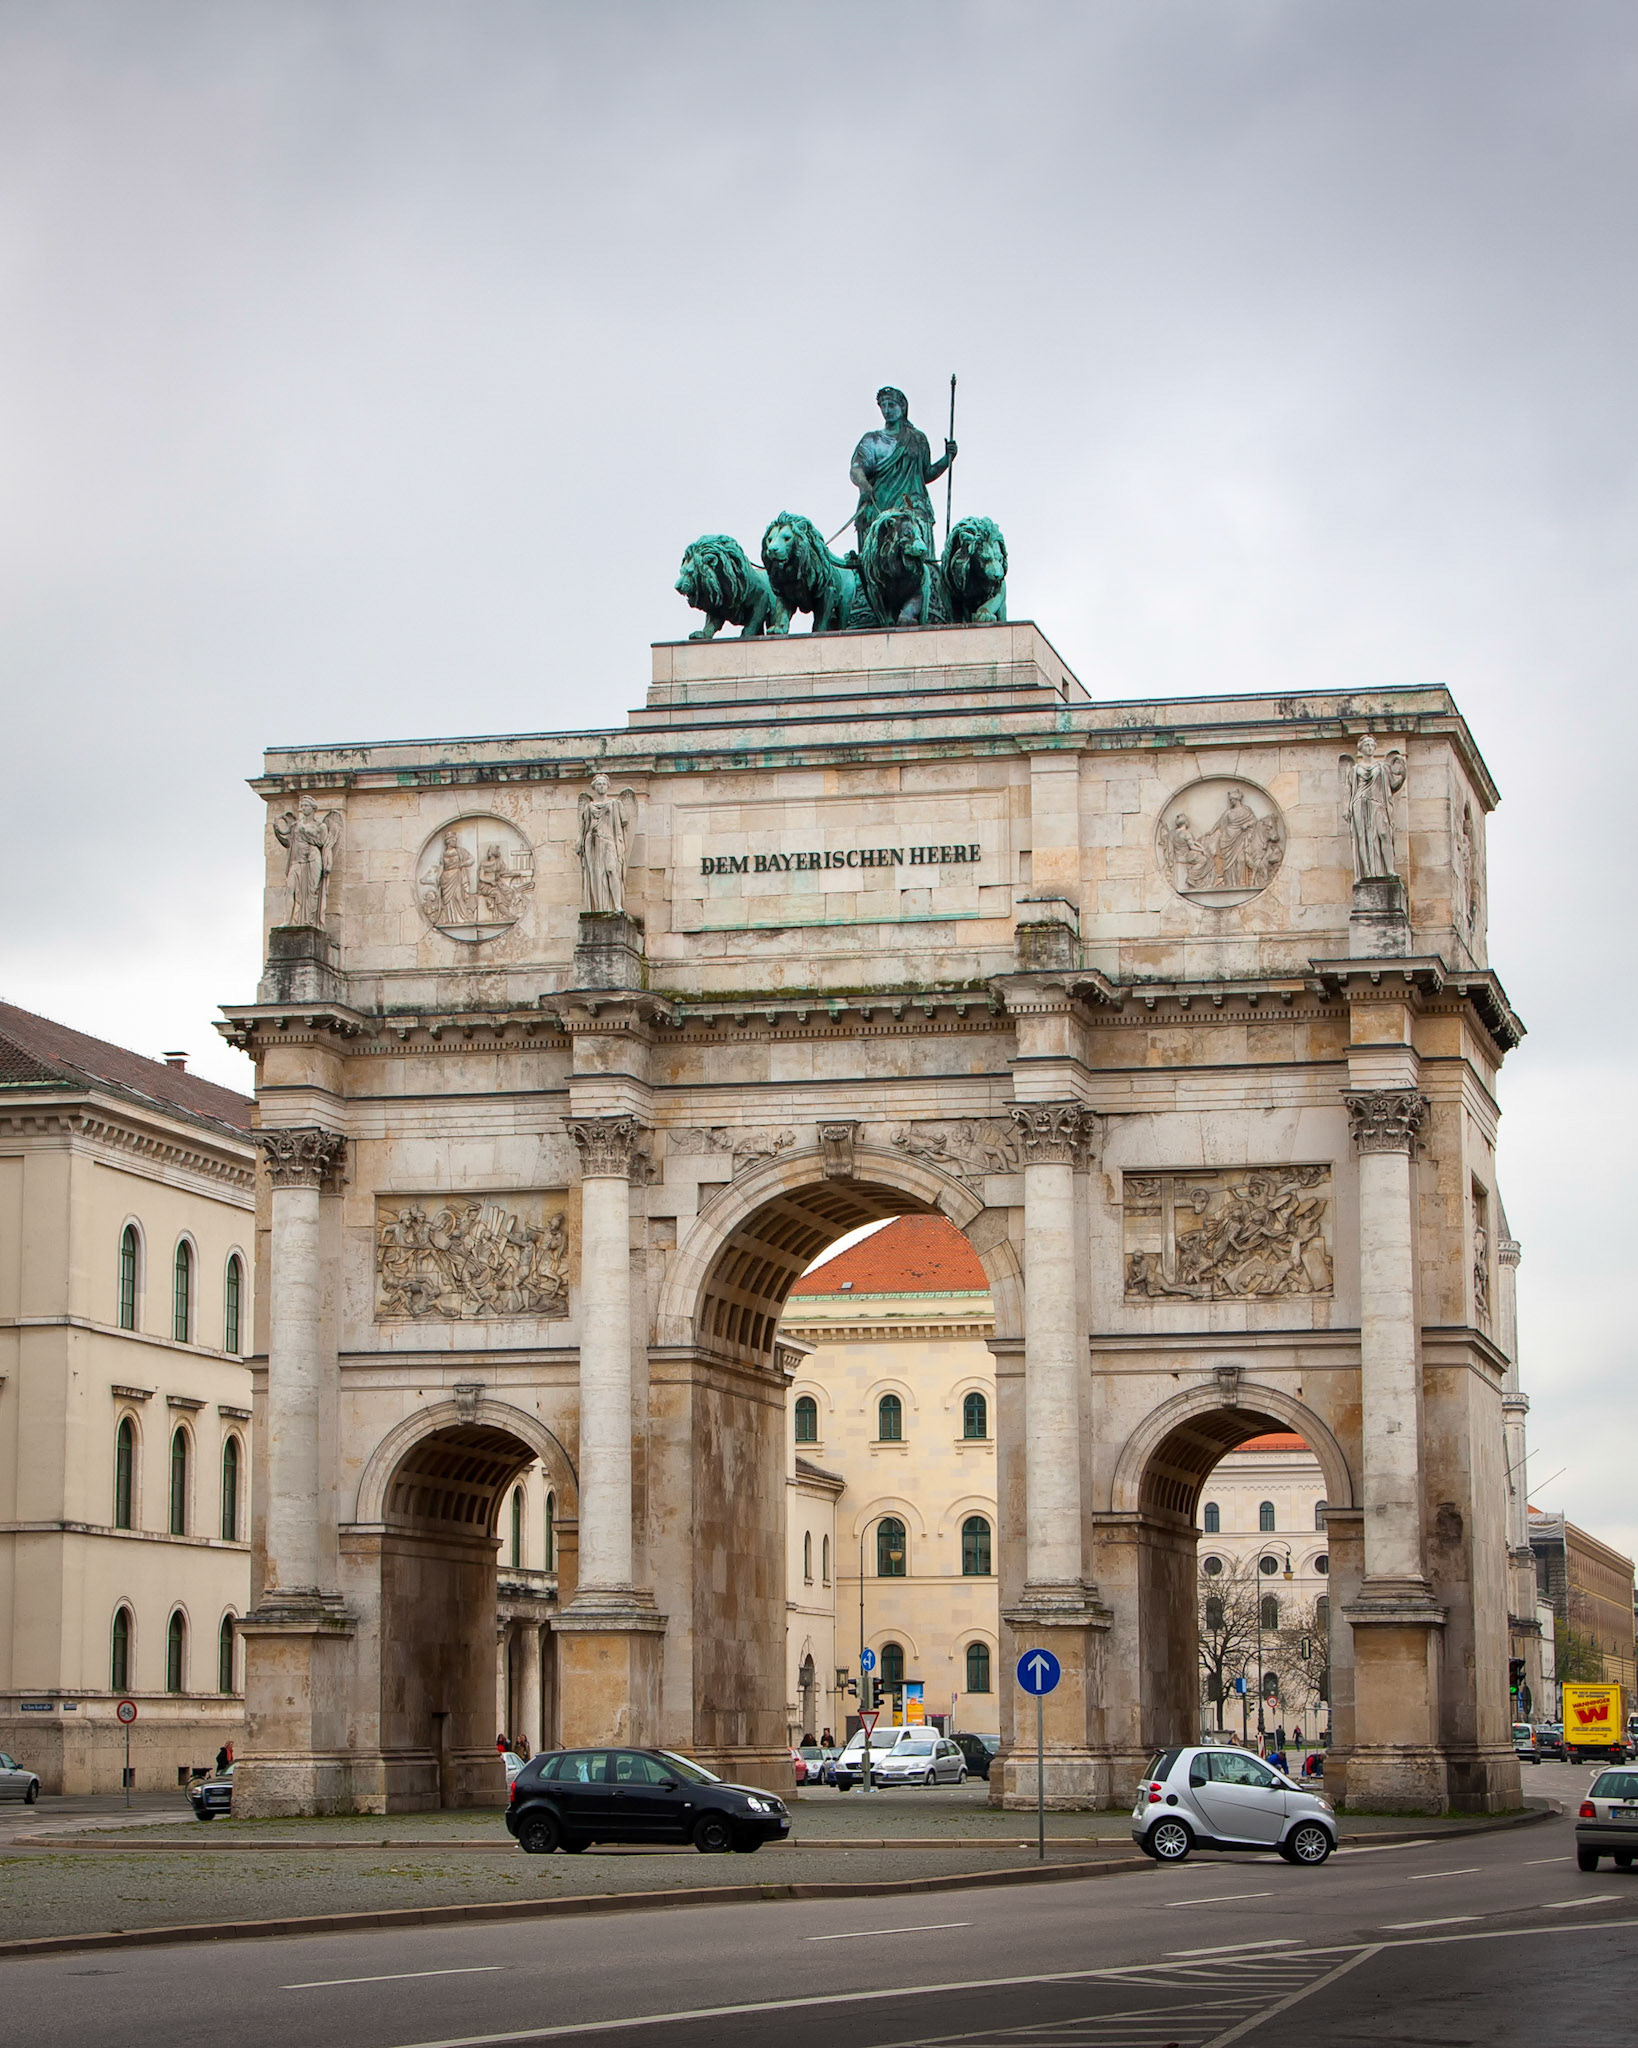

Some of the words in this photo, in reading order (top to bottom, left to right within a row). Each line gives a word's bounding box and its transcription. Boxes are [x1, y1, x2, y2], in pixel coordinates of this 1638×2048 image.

[701, 855, 749, 875] DEM
[753, 848, 904, 873] BAYERISCHEN
[909, 844, 981, 865] HEERE
[1576, 1705, 1609, 1724] W
